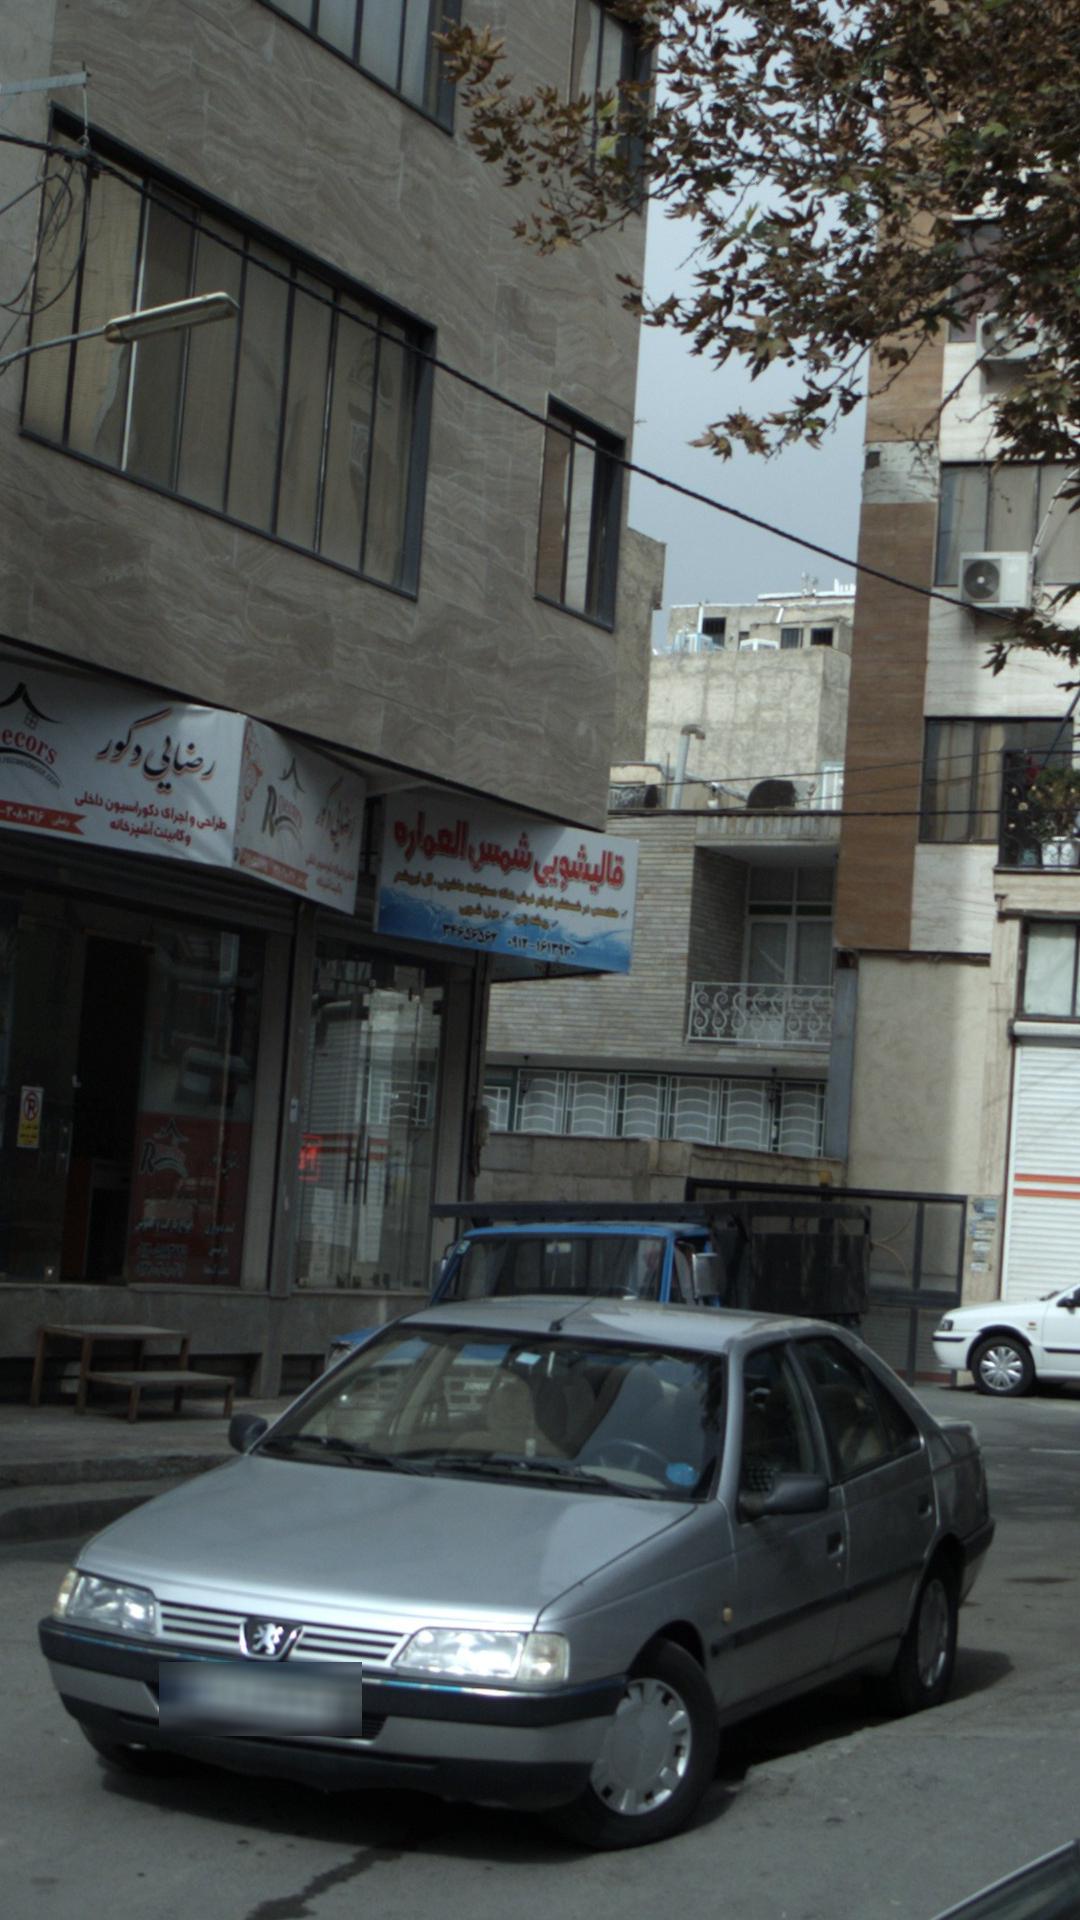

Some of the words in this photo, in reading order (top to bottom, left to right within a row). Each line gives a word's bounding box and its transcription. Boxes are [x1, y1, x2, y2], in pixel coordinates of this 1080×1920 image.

[0, 729, 58, 765] ecors
[95, 707, 173, 767] دکور
[74, 791, 103, 807] داخلی
[105, 799, 159, 817] دکوراسیون
[161, 808, 189, 825] اجرای
[196, 816, 227, 832] طراحی
[154, 827, 185, 843] کابینت
[394, 811, 468, 860] العماره
[468, 832, 533, 873] شمس
[534, 844, 625, 893] قالیشویی
